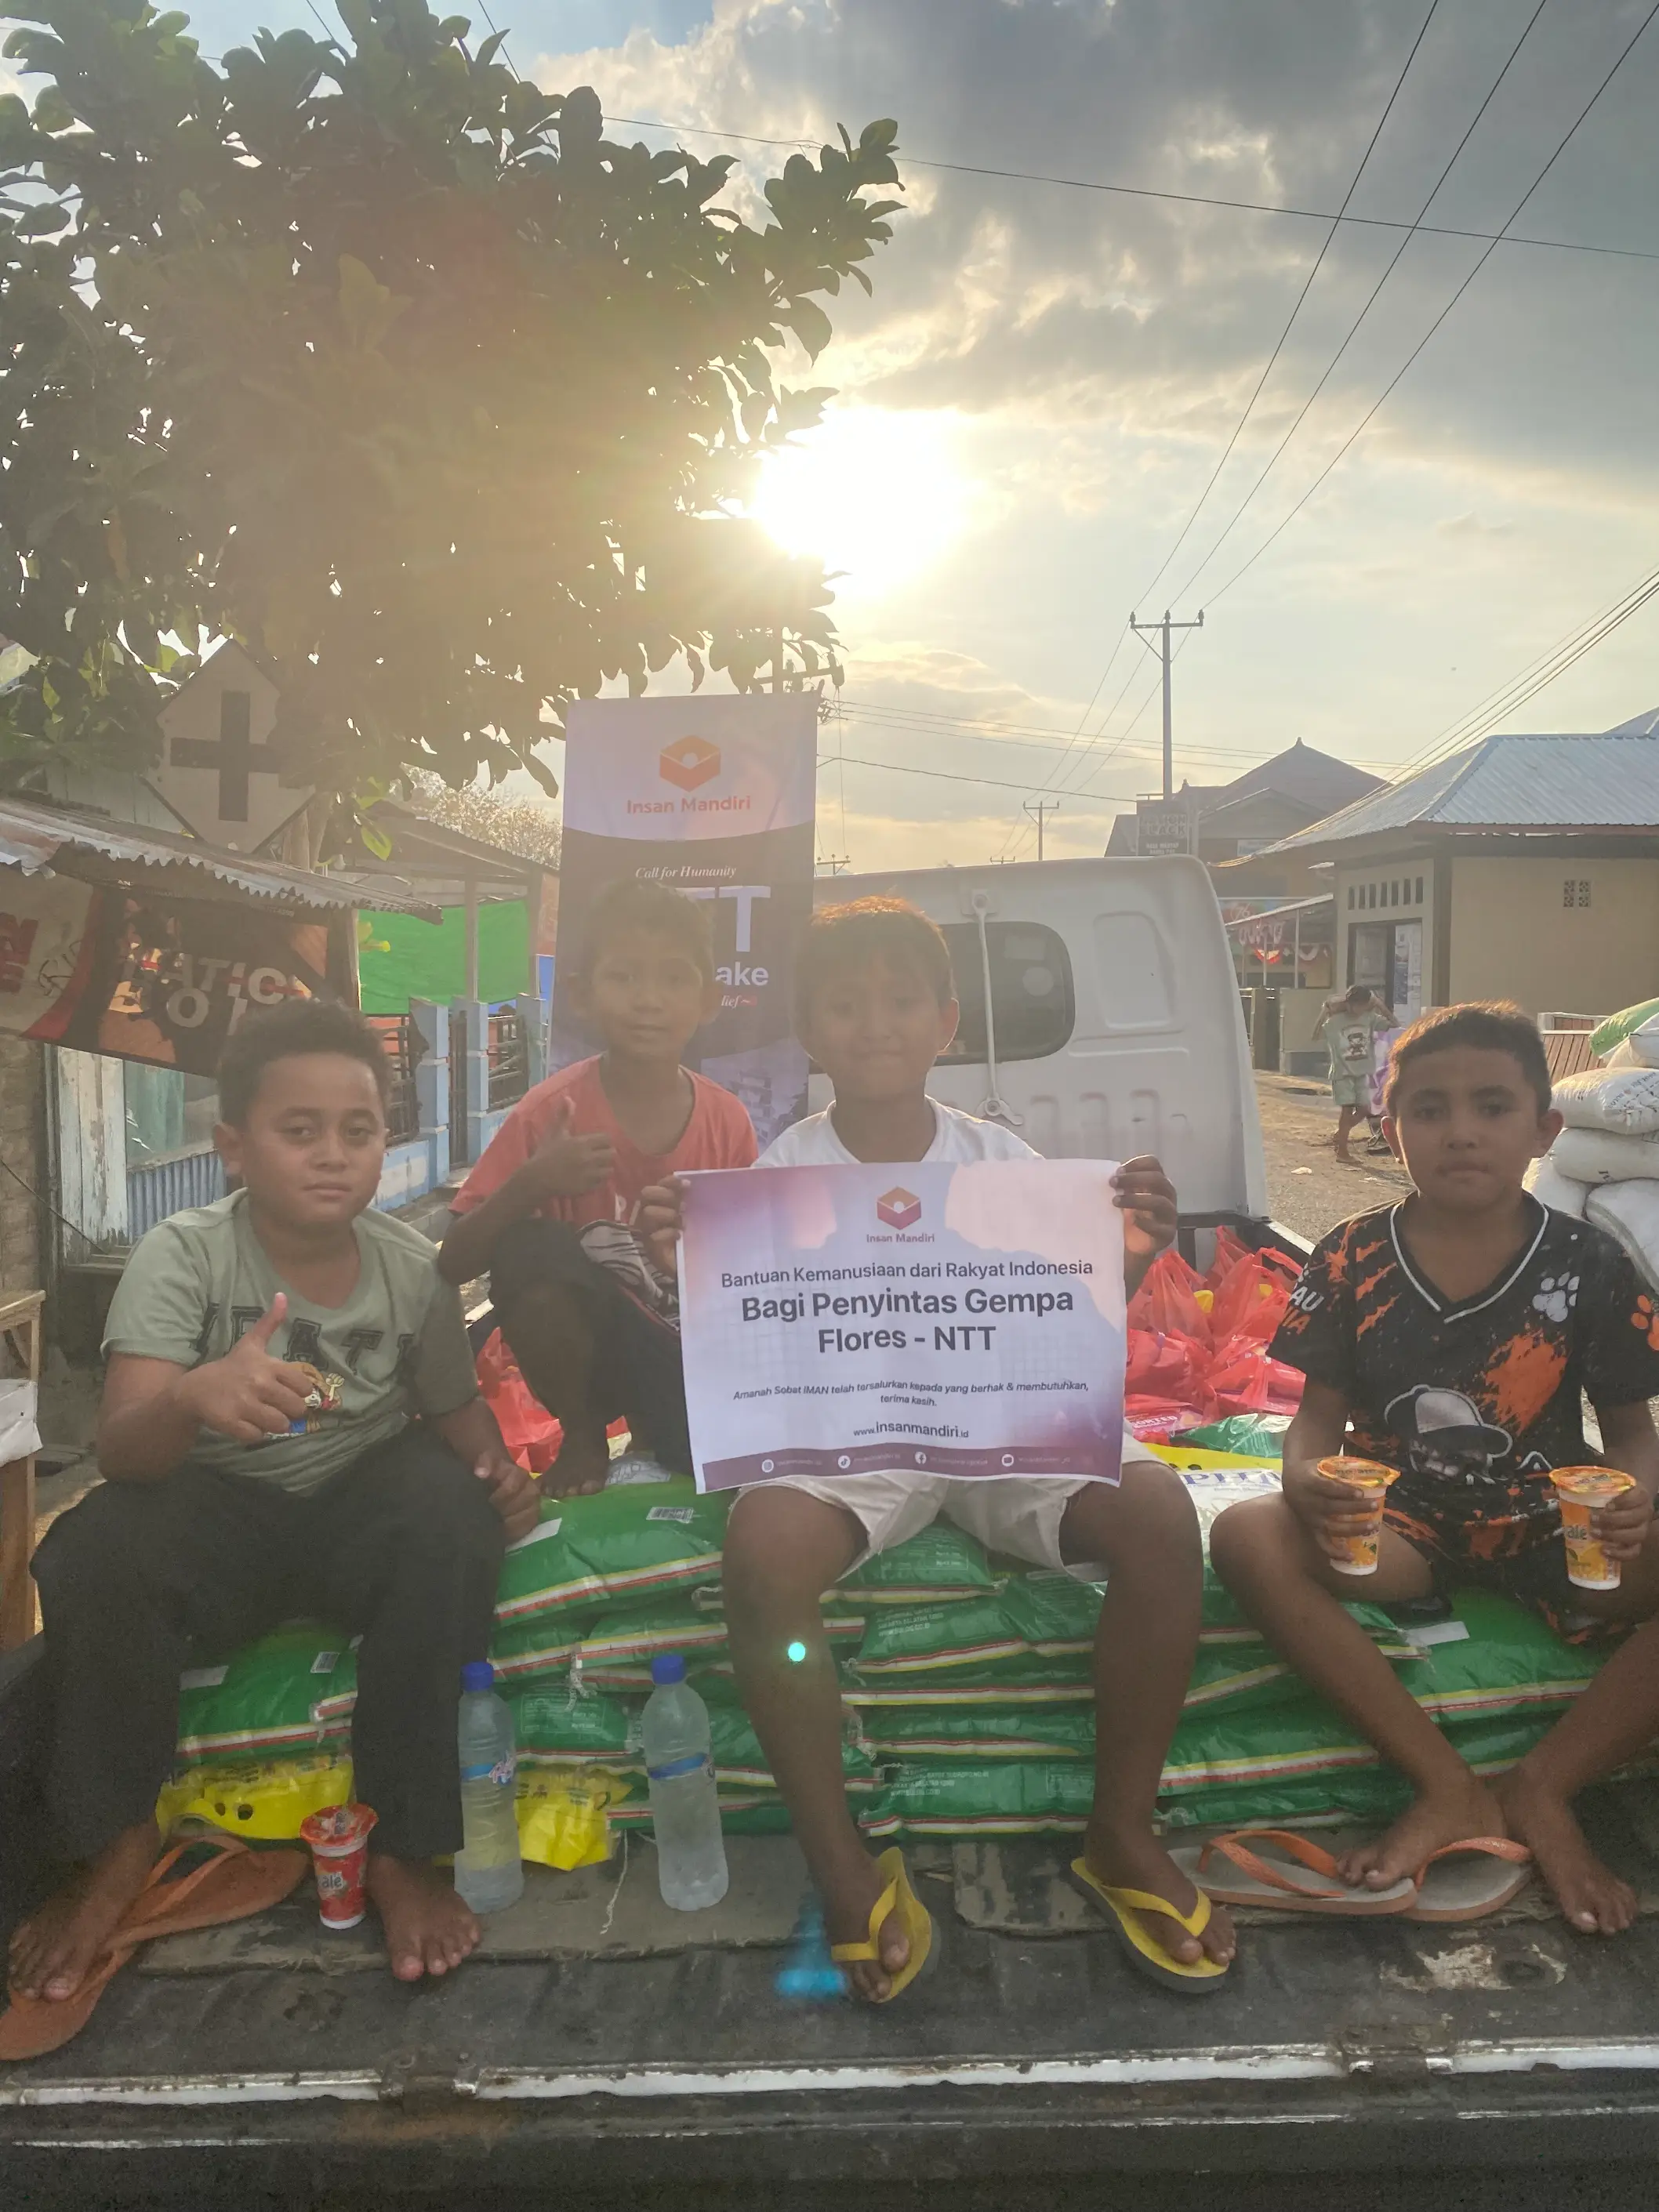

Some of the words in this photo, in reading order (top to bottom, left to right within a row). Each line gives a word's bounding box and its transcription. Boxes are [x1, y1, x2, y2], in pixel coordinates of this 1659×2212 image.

[627, 800, 675, 814] Insan
[681, 796, 750, 812] Mandiri
[635, 866, 659, 879] Call
[659, 866, 678, 879] for
[680, 865, 737, 878] Humanity
[714, 961, 769, 986] ake
[866, 1234, 892, 1243] Insan
[895, 1233, 935, 1243] Mandiri
[721, 1269, 790, 1288] Bantuan
[793, 1263, 906, 1282] Kemanusiaan
[909, 1263, 942, 1278] dari
[946, 1262, 1005, 1280] Rakyat
[1009, 1260, 1093, 1276] Indonesia
[742, 1293, 805, 1322] Bagi
[812, 1287, 957, 1318] Penyintas
[964, 1289, 1073, 1317] Gempa
[819, 1329, 907, 1353] Flores
[934, 1326, 996, 1351] NTT
[733, 1387, 772, 1401] Amanah
[774, 1385, 801, 1394] Sobat
[831, 1383, 855, 1394] telah
[857, 1380, 908, 1391] tersalurkan
[909, 1381, 942, 1393] kepada
[944, 1384, 968, 1394] yang
[971, 1383, 1004, 1393] berhak
[1006, 1382, 1014, 1391] &
[1016, 1380, 1089, 1392] membutuhkan,
[880, 1394, 909, 1404] terima
[911, 1396, 938, 1407] kasih.
[853, 1420, 969, 1438] www.insanmandiri.id
